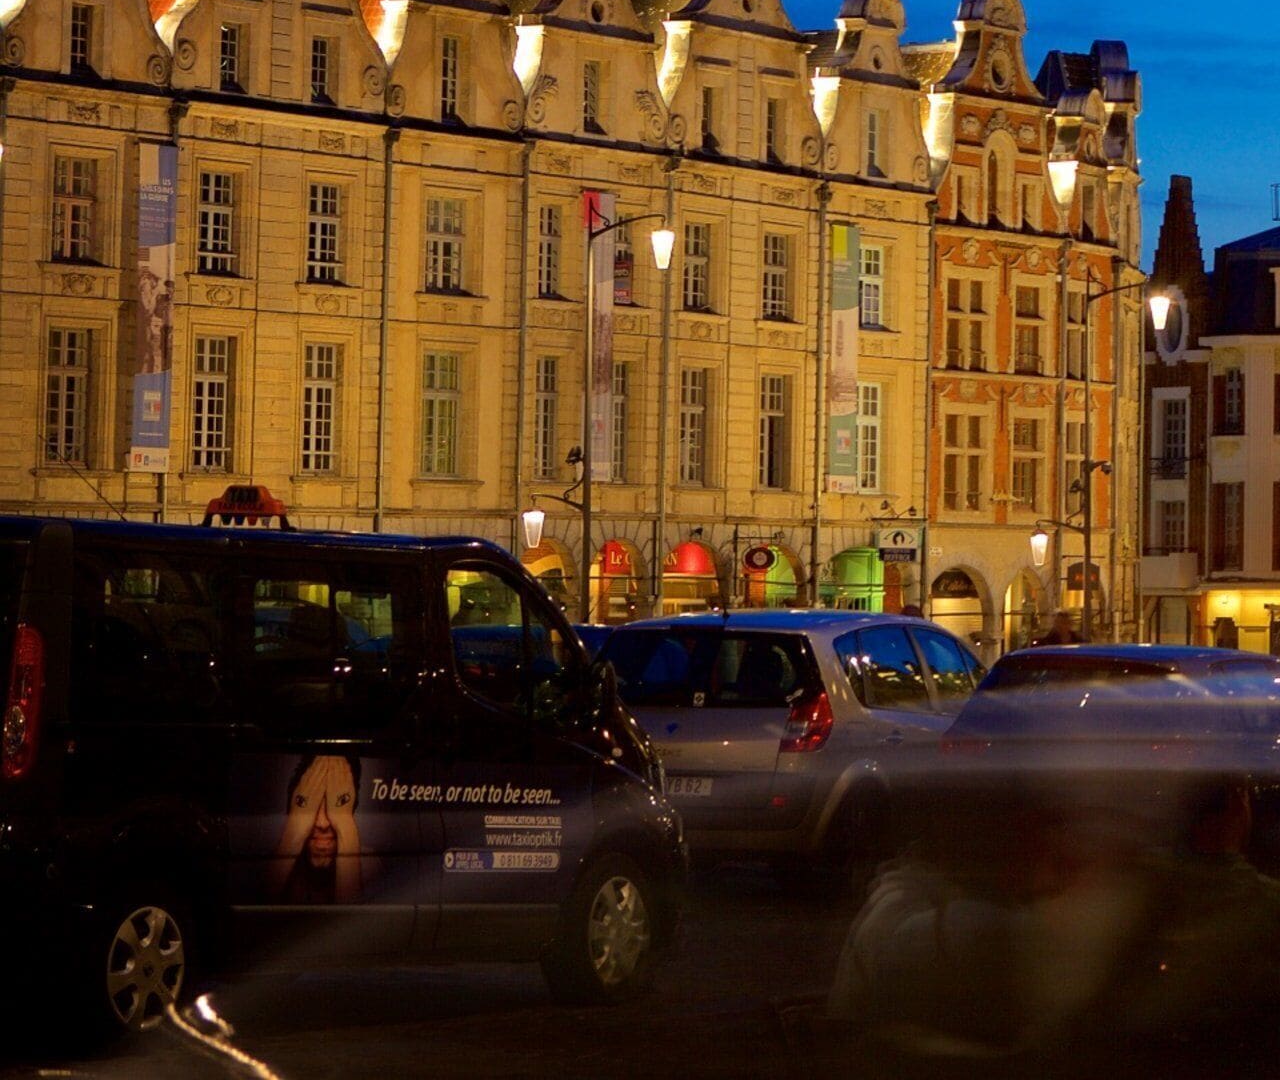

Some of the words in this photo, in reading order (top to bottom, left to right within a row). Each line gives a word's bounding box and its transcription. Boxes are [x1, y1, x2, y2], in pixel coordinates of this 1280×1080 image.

[371, 779, 388, 800] To
[390, 779, 406, 801] be
[409, 784, 443, 803] seen,
[446, 785, 462, 801] or
[463, 784, 487, 804] not
[489, 784, 502, 804] to
[504, 782, 520, 804] be
[521, 787, 561, 806] seen...
[486, 830, 562, 848] www.taxioptik.fr
